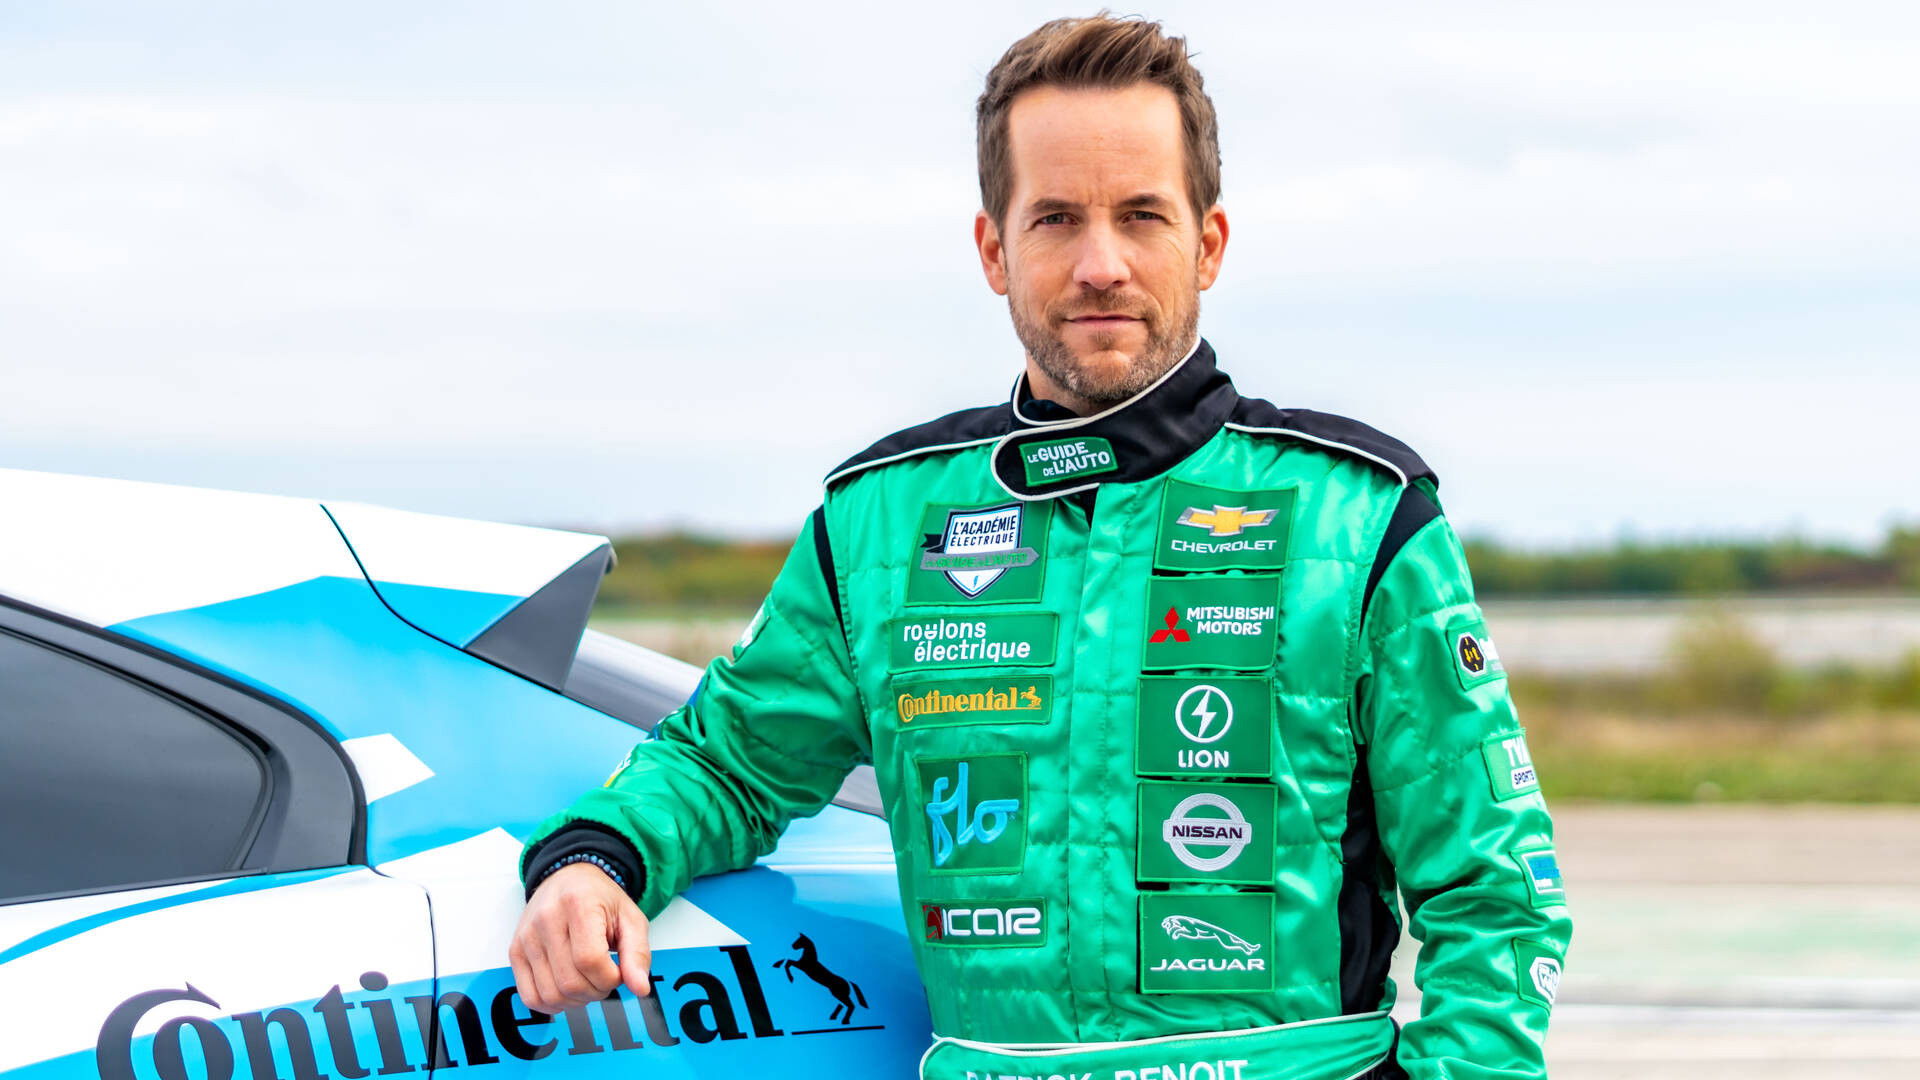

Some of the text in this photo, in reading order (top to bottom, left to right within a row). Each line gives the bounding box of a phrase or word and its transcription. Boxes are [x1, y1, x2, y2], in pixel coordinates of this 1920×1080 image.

[1027, 442, 1089, 463] LE GUIDE
[1043, 451, 1110, 477] DE L'AUTO
[952, 515, 1017, 535] L'ACADÉMIE
[950, 531, 1014, 547] ÉLECTRIQUE
[1171, 539, 1277, 553] CHEVROLET
[1186, 606, 1274, 622] MITSUBISHI
[1197, 621, 1262, 635] MOTORS
[914, 638, 1031, 663] électrique
[897, 686, 1018, 723] Continental
[1178, 750, 1230, 768] LION
[926, 762, 1019, 866] flo
[1172, 825, 1243, 839] NISSAN
[1150, 958, 1266, 971] JAGUAR
